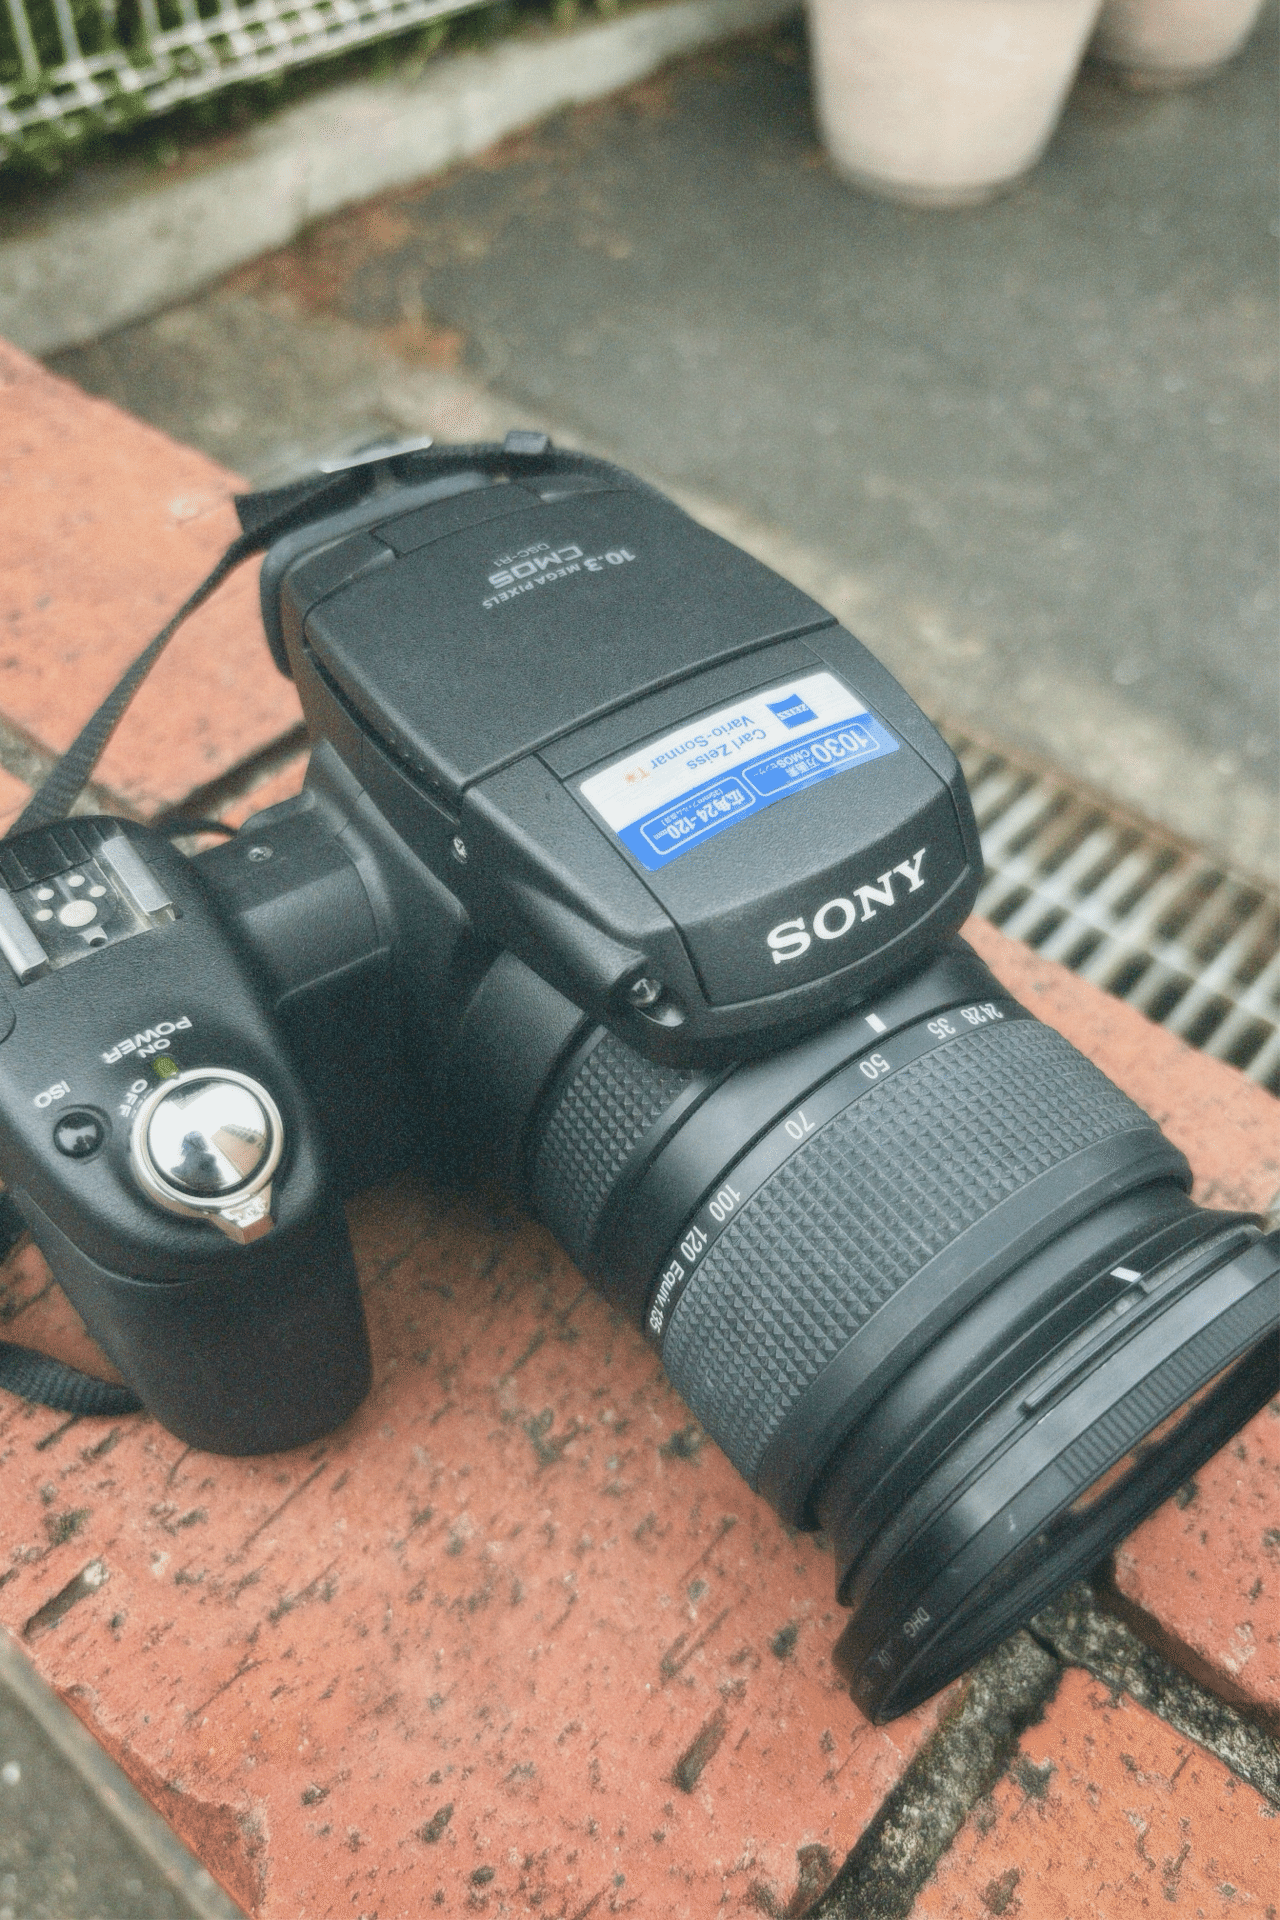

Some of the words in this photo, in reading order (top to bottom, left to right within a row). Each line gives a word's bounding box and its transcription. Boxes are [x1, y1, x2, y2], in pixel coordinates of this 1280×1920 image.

[489, 546, 583, 589] CMOS
[494, 543, 550, 567] DSC-R1
[583, 549, 636, 572] 10.3
[534, 563, 581, 585] MEGA
[482, 581, 534, 609] PIXELS
[650, 715, 755, 769] Vario-Sonnar
[731, 728, 766, 750] Carl
[810, 730, 869, 763] 1030
[686, 743, 732, 770] Zeiss
[767, 847, 926, 965] SONY
[960, 1007, 987, 1025] 28
[979, 1003, 1005, 1020] 24
[101, 1016, 193, 1064] POWER
[927, 1017, 957, 1040] 35
[136, 1038, 171, 1058] ON
[859, 1053, 890, 1079] 50
[33, 1081, 71, 1108] ISO
[120, 1078, 148, 1118] OFF
[784, 1110, 816, 1140] 70
[709, 1184, 741, 1221] 100
[680, 1225, 707, 1262] 120
[903, 1606, 931, 1638] DHG
